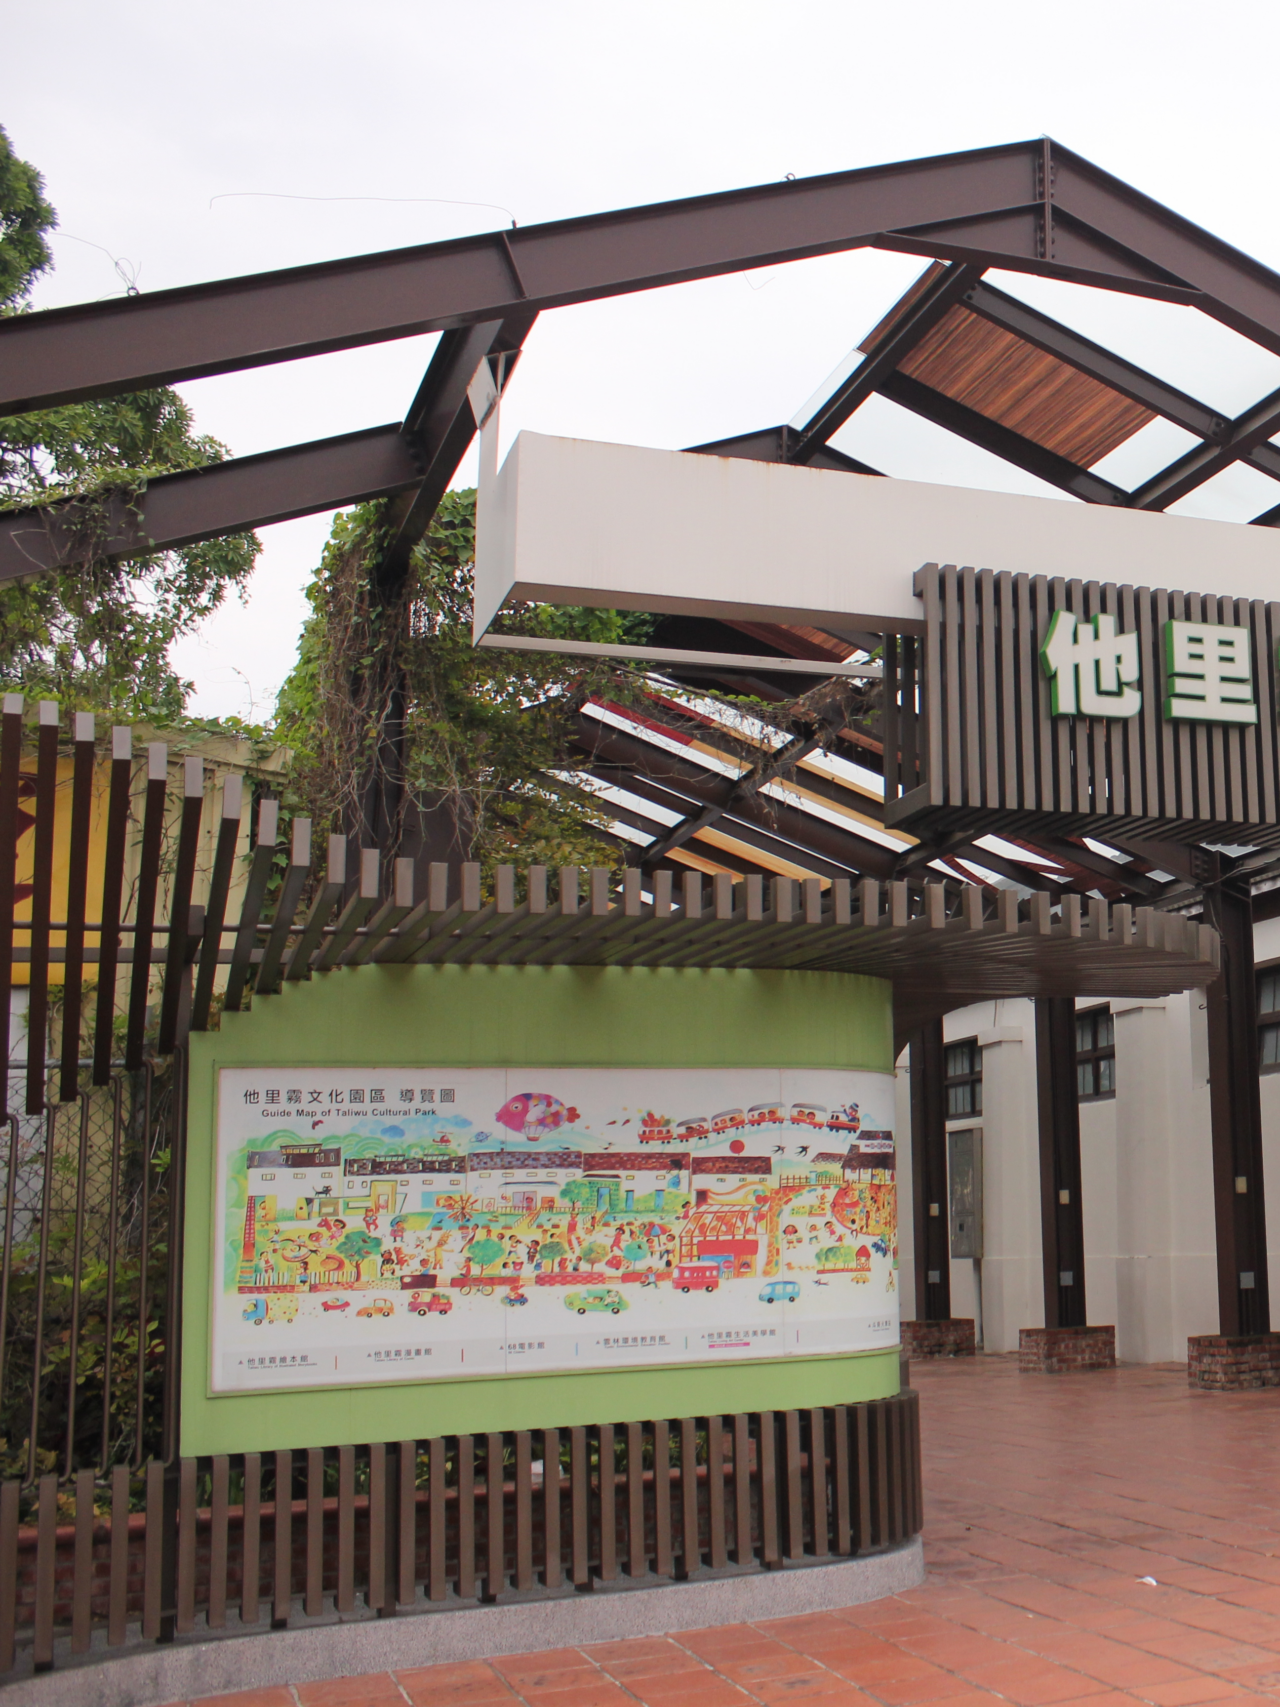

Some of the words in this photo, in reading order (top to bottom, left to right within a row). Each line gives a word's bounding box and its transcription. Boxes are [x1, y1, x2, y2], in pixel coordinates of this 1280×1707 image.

[243, 1088, 386, 1105] 他里霧文化園區
[399, 1088, 455, 1104] 導覽圖
[261, 1109, 292, 1118] Guide
[296, 1109, 317, 1119] Map
[321, 1108, 332, 1117] of
[335, 1108, 368, 1117] Taliwu
[371, 1108, 411, 1117] Cultural
[415, 1107, 437, 1116] Park
